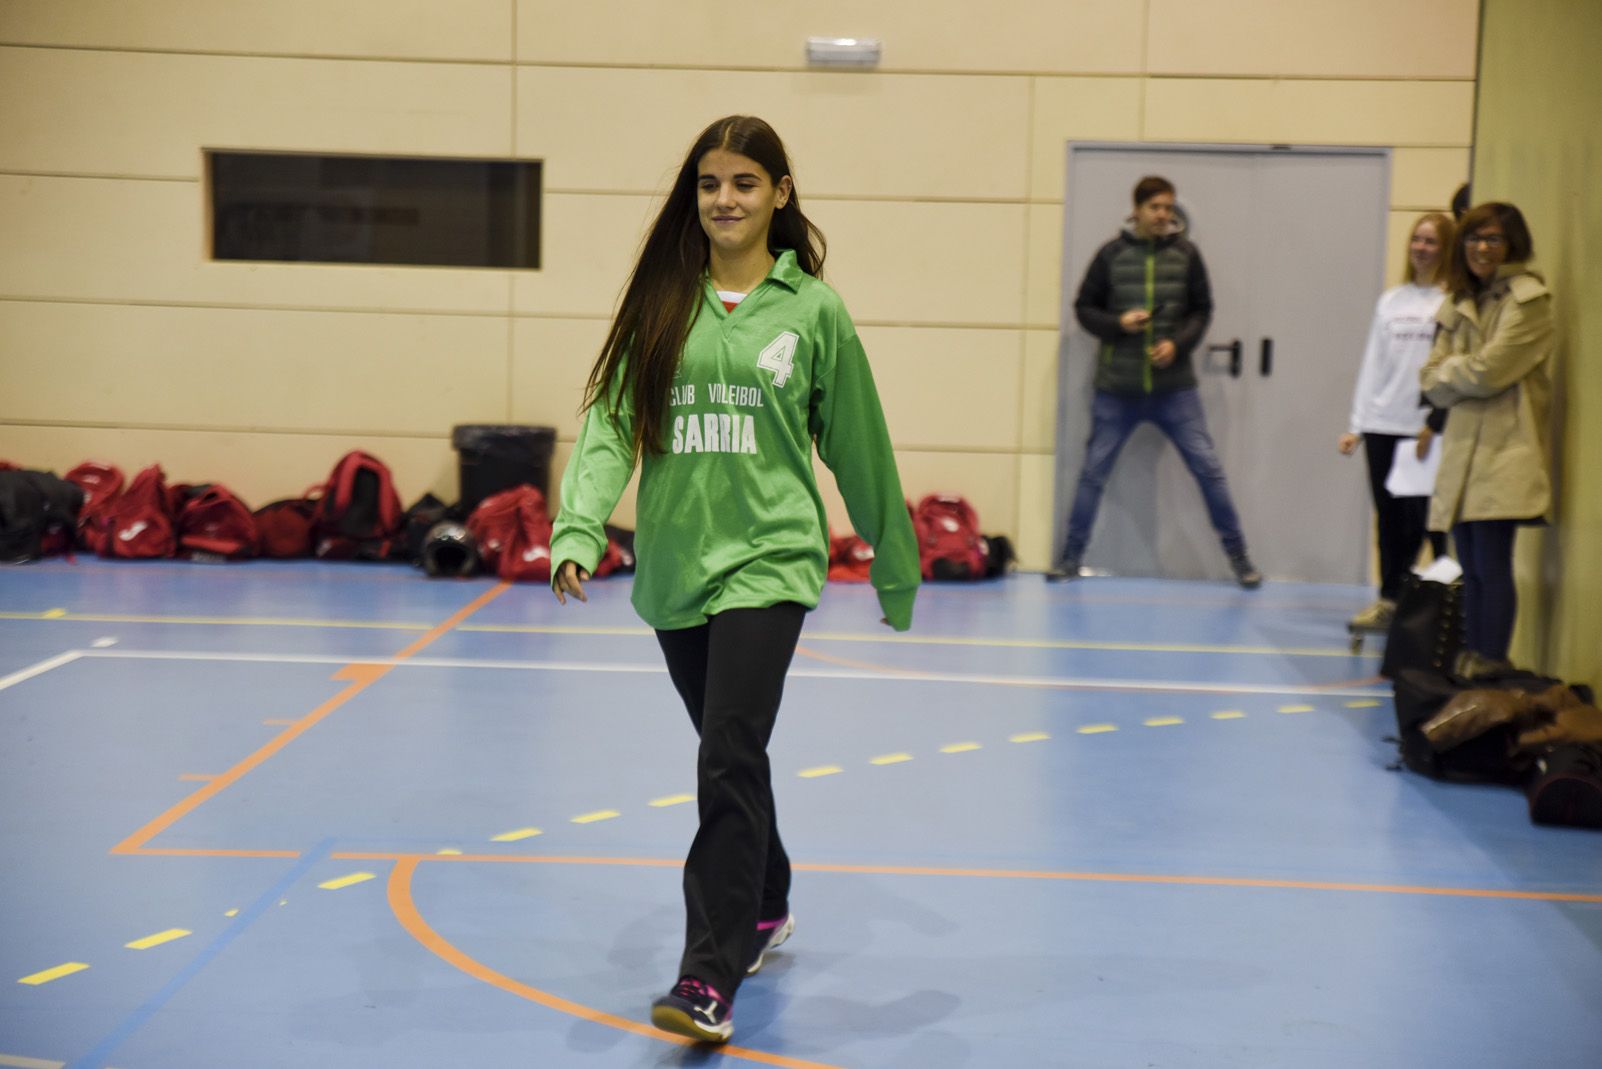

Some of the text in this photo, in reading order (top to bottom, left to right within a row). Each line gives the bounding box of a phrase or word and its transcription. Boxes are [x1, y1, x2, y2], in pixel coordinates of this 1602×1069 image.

[757, 331, 800, 388] 4
[708, 383, 764, 408] VOLEIBOL
[672, 413, 757, 455] SARRIA
